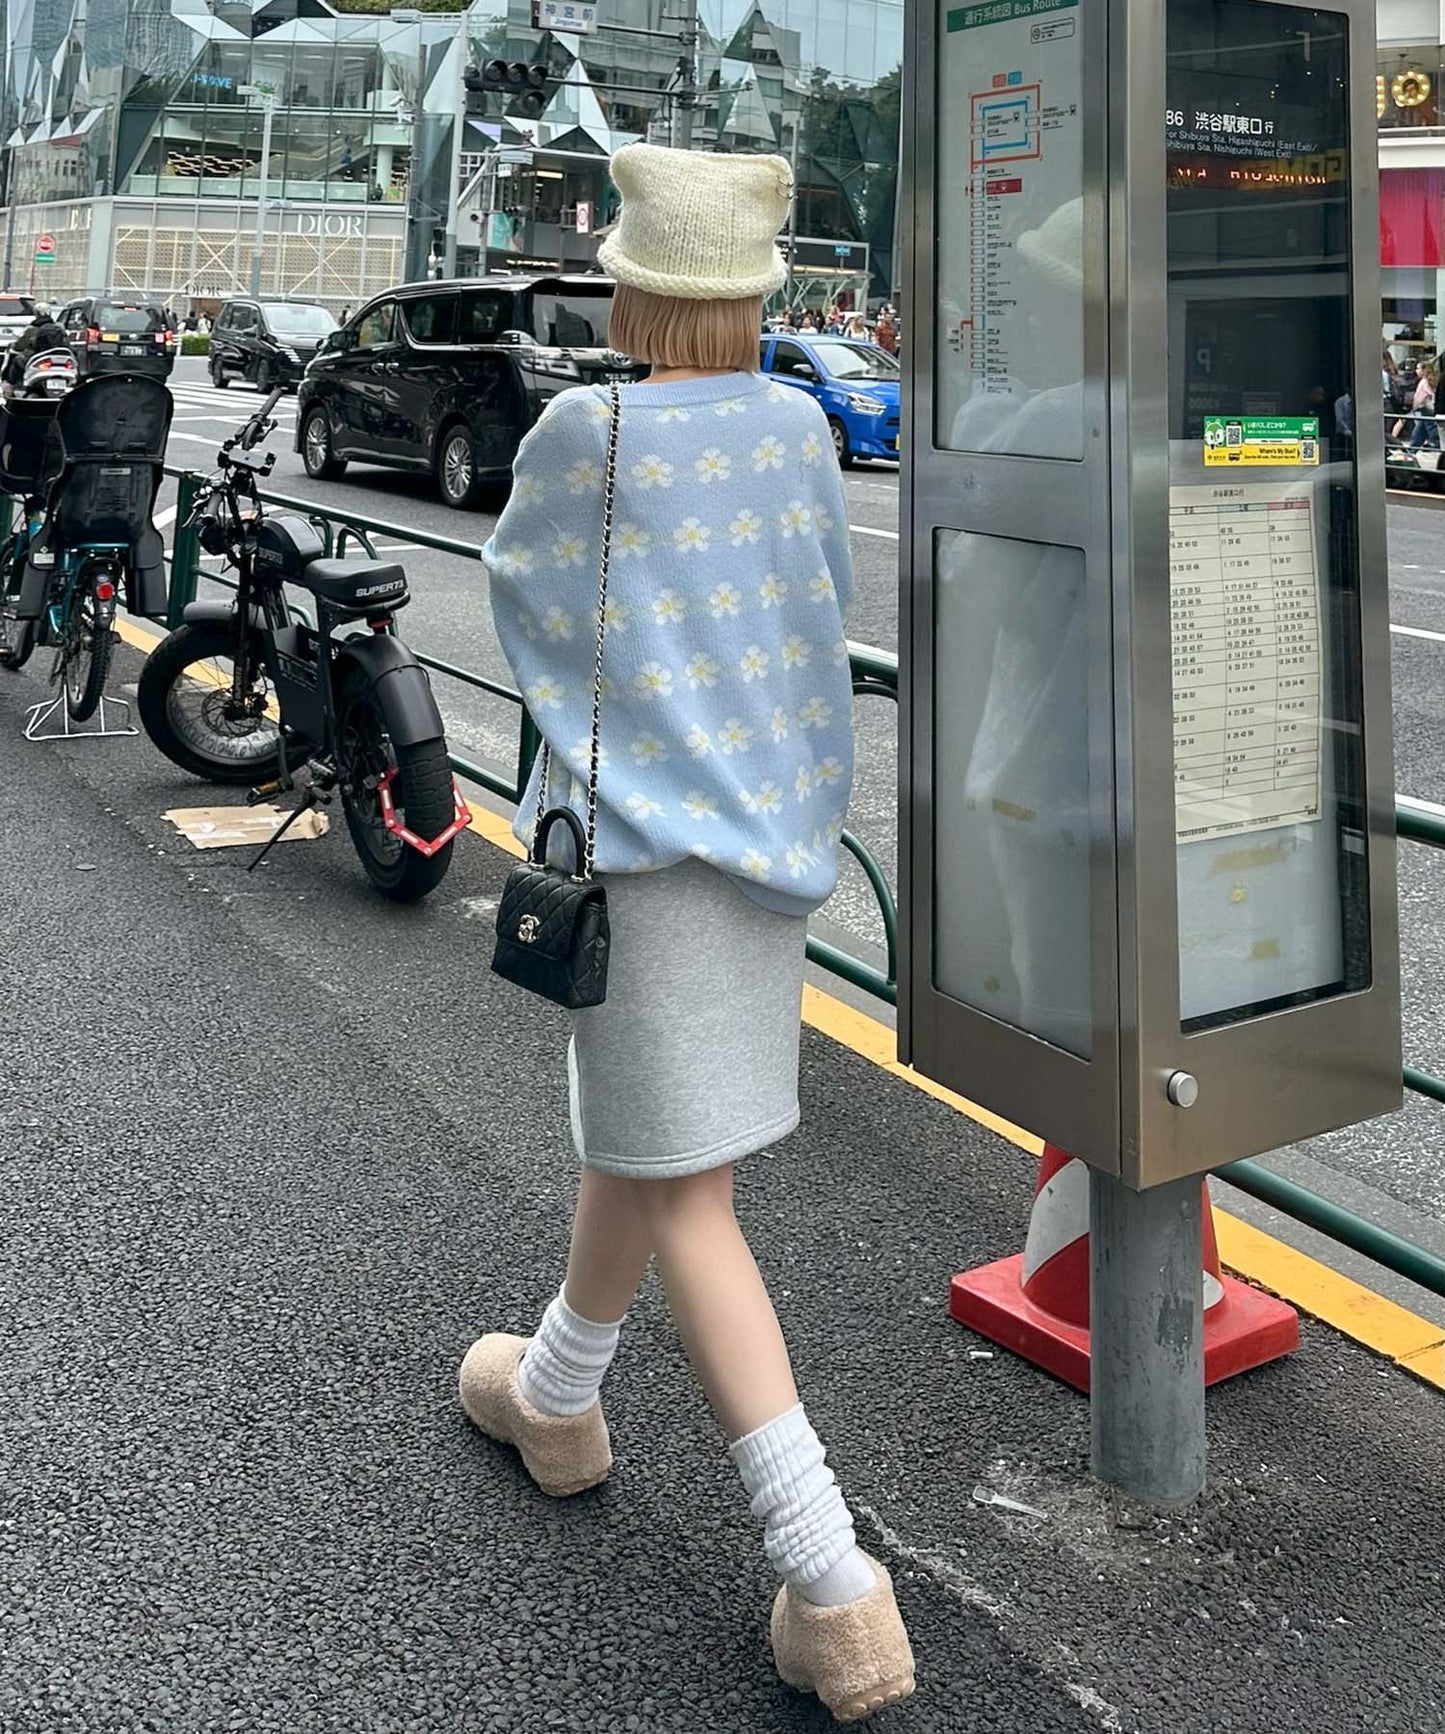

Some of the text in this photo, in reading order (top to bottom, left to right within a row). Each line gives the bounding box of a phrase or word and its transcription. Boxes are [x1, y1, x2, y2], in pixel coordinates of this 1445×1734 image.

[545, 3, 593, 21] 神宮前
[1014, 3, 1031, 15] Bus
[1032, 0, 1062, 11] Route
[1195, 111, 1274, 135] 渋谷駅東口行
[1179, 131, 1210, 142] Shibuya
[1212, 133, 1227, 143] Sta.
[1229, 135, 1275, 149] Higashiguchi
[1197, 142, 1212, 151] Sta.
[1214, 144, 1252, 156] Nishiguchi
[297, 214, 363, 236] DIOR
[355, 580, 405, 598] SUPER73
